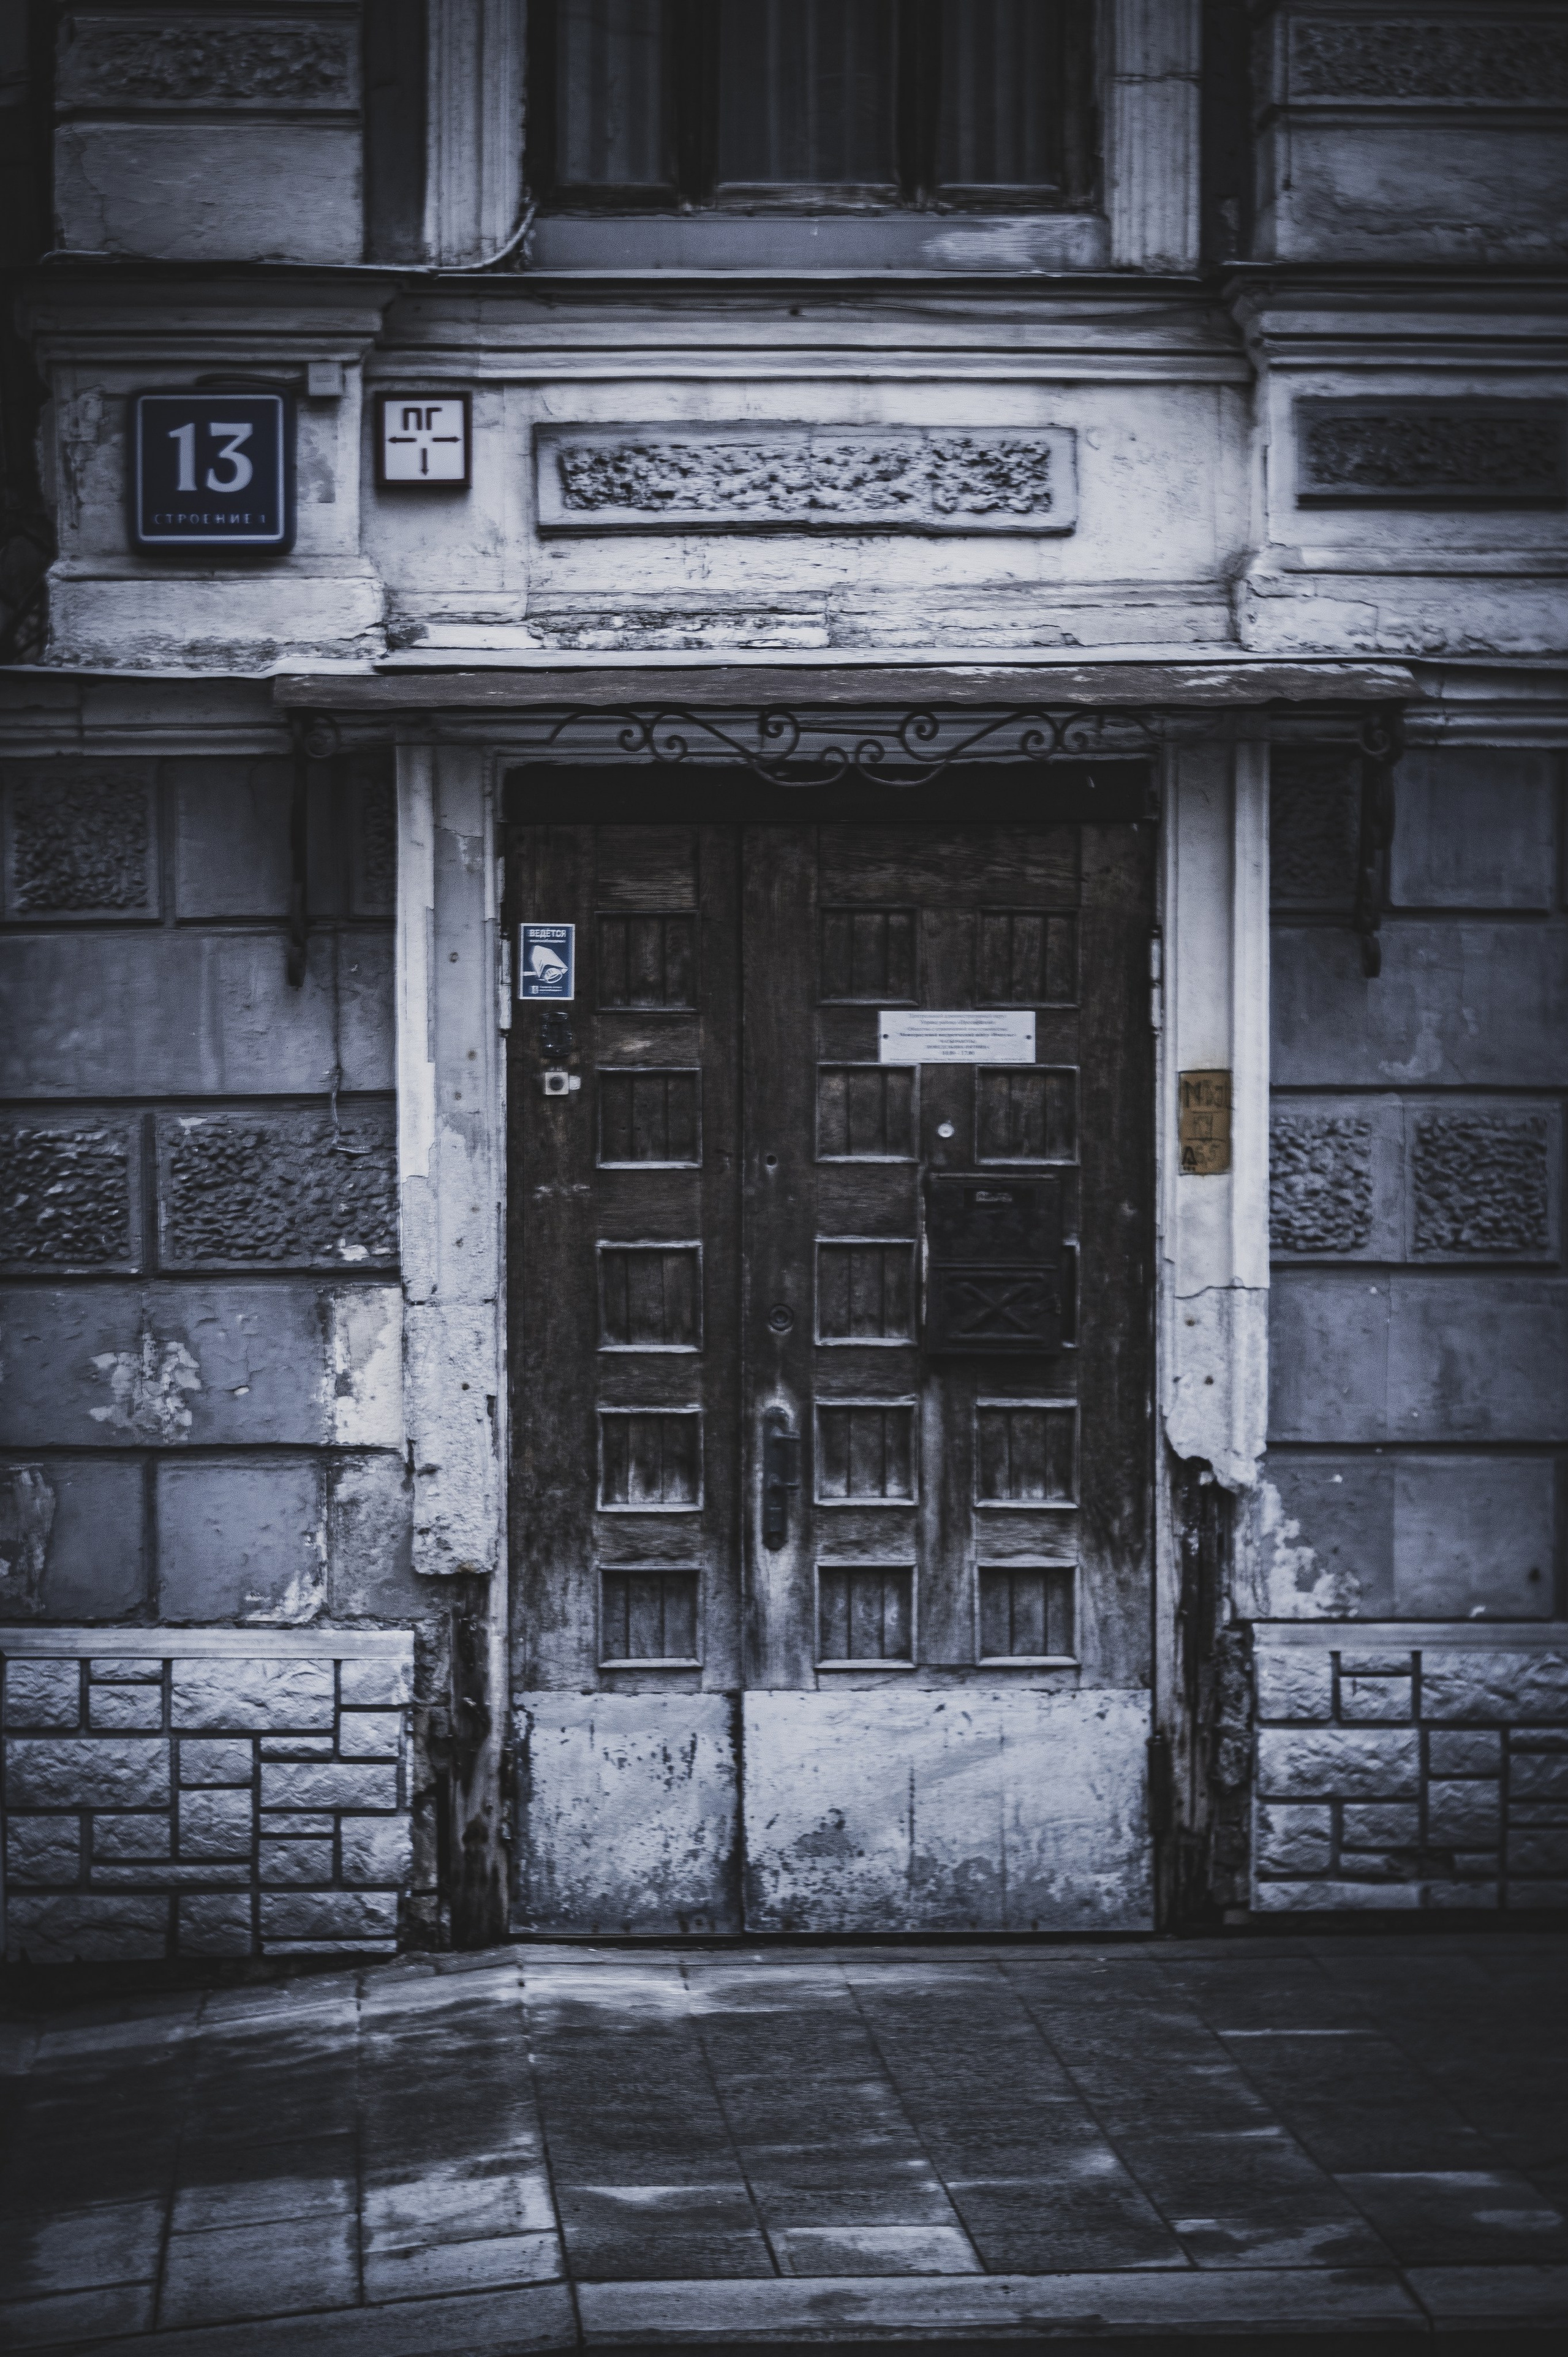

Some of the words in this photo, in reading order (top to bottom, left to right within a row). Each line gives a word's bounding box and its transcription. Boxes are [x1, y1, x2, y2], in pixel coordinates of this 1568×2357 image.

[167, 421, 254, 493] 13
[154, 513, 252, 525] СТРОЕНИЕ
[258, 514, 266, 524] 1
